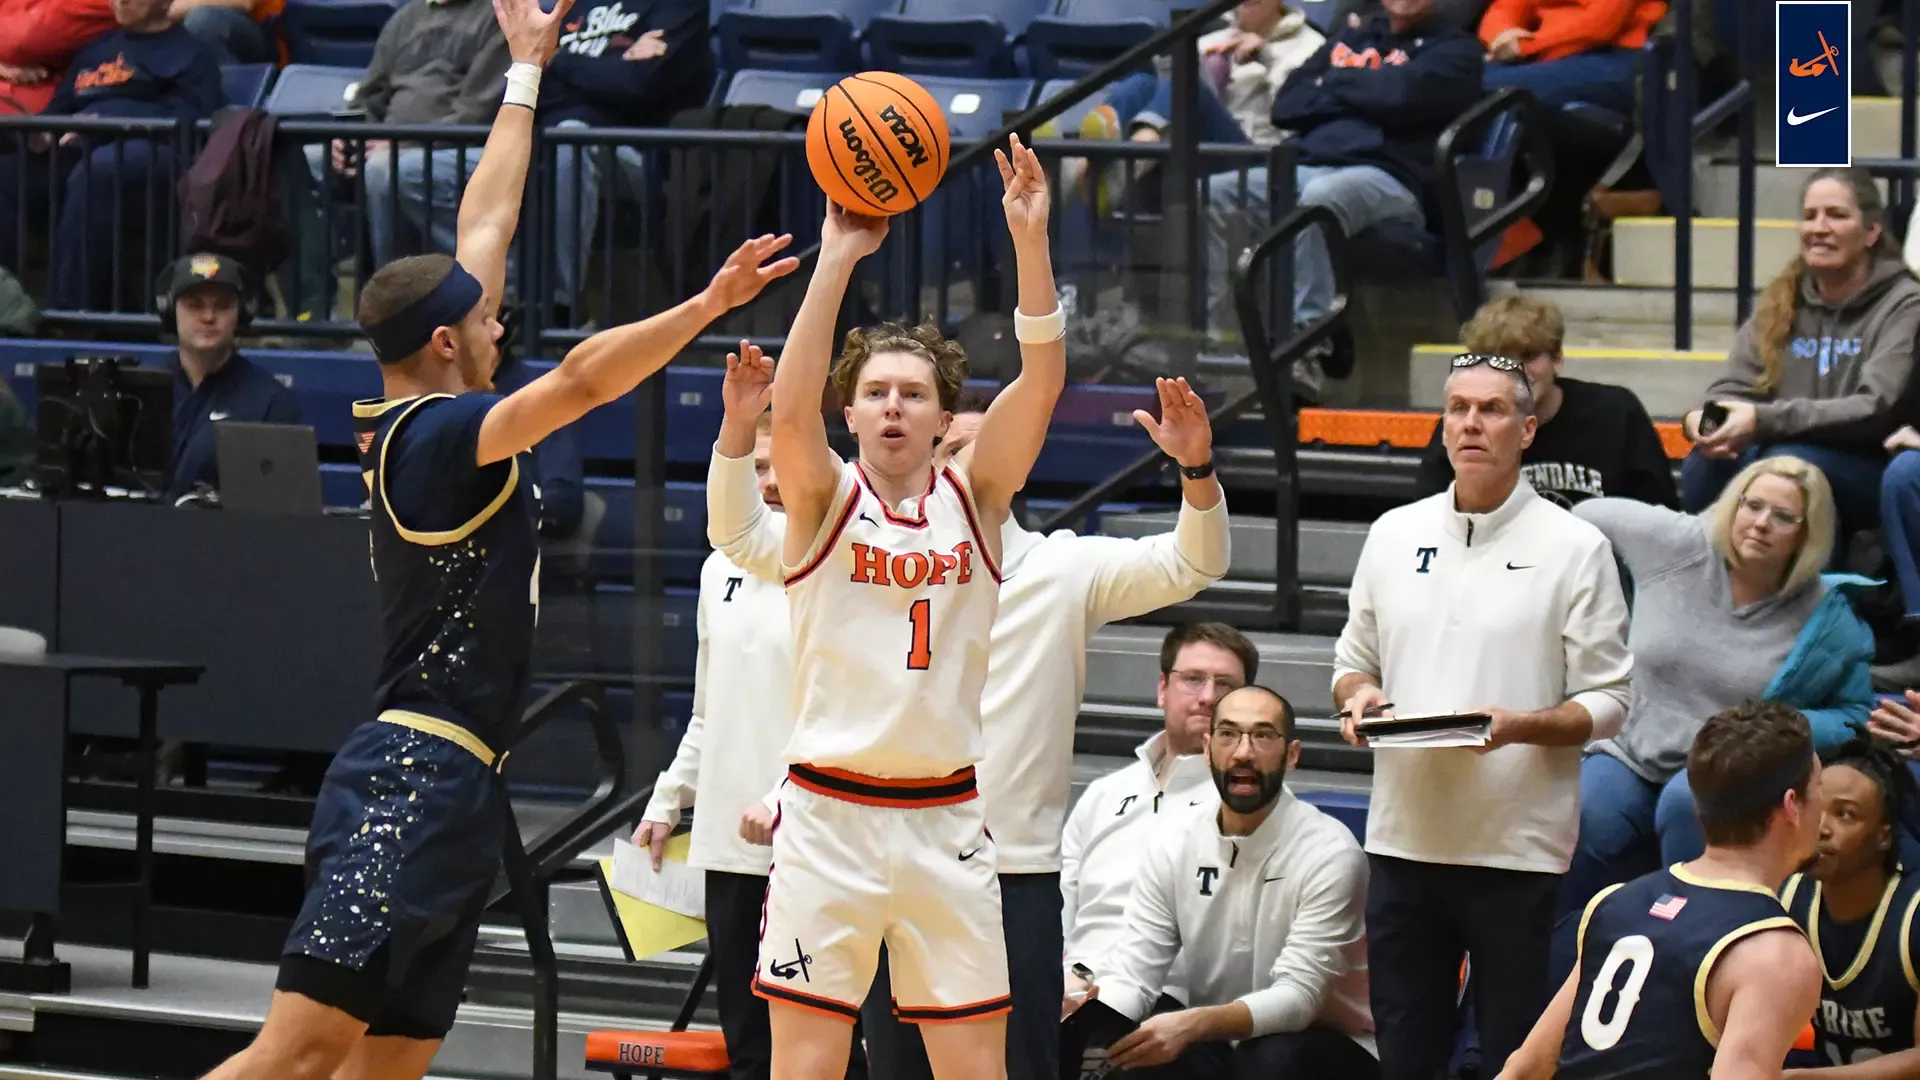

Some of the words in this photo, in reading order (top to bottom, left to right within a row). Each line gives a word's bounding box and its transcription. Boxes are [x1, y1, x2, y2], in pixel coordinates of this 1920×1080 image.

[880, 104, 929, 168] NCAA
[839, 116, 899, 204] Wilson
[850, 540, 973, 589] HOPE
[1416, 547, 1438, 574] T
[723, 576, 743, 602] T
[907, 598, 932, 670] 1
[1115, 794, 1138, 816] T
[1196, 866, 1219, 896] T
[1580, 934, 1655, 1051] 0
[1815, 999, 1892, 1039] RINE
[618, 1042, 665, 1066] HOPE
